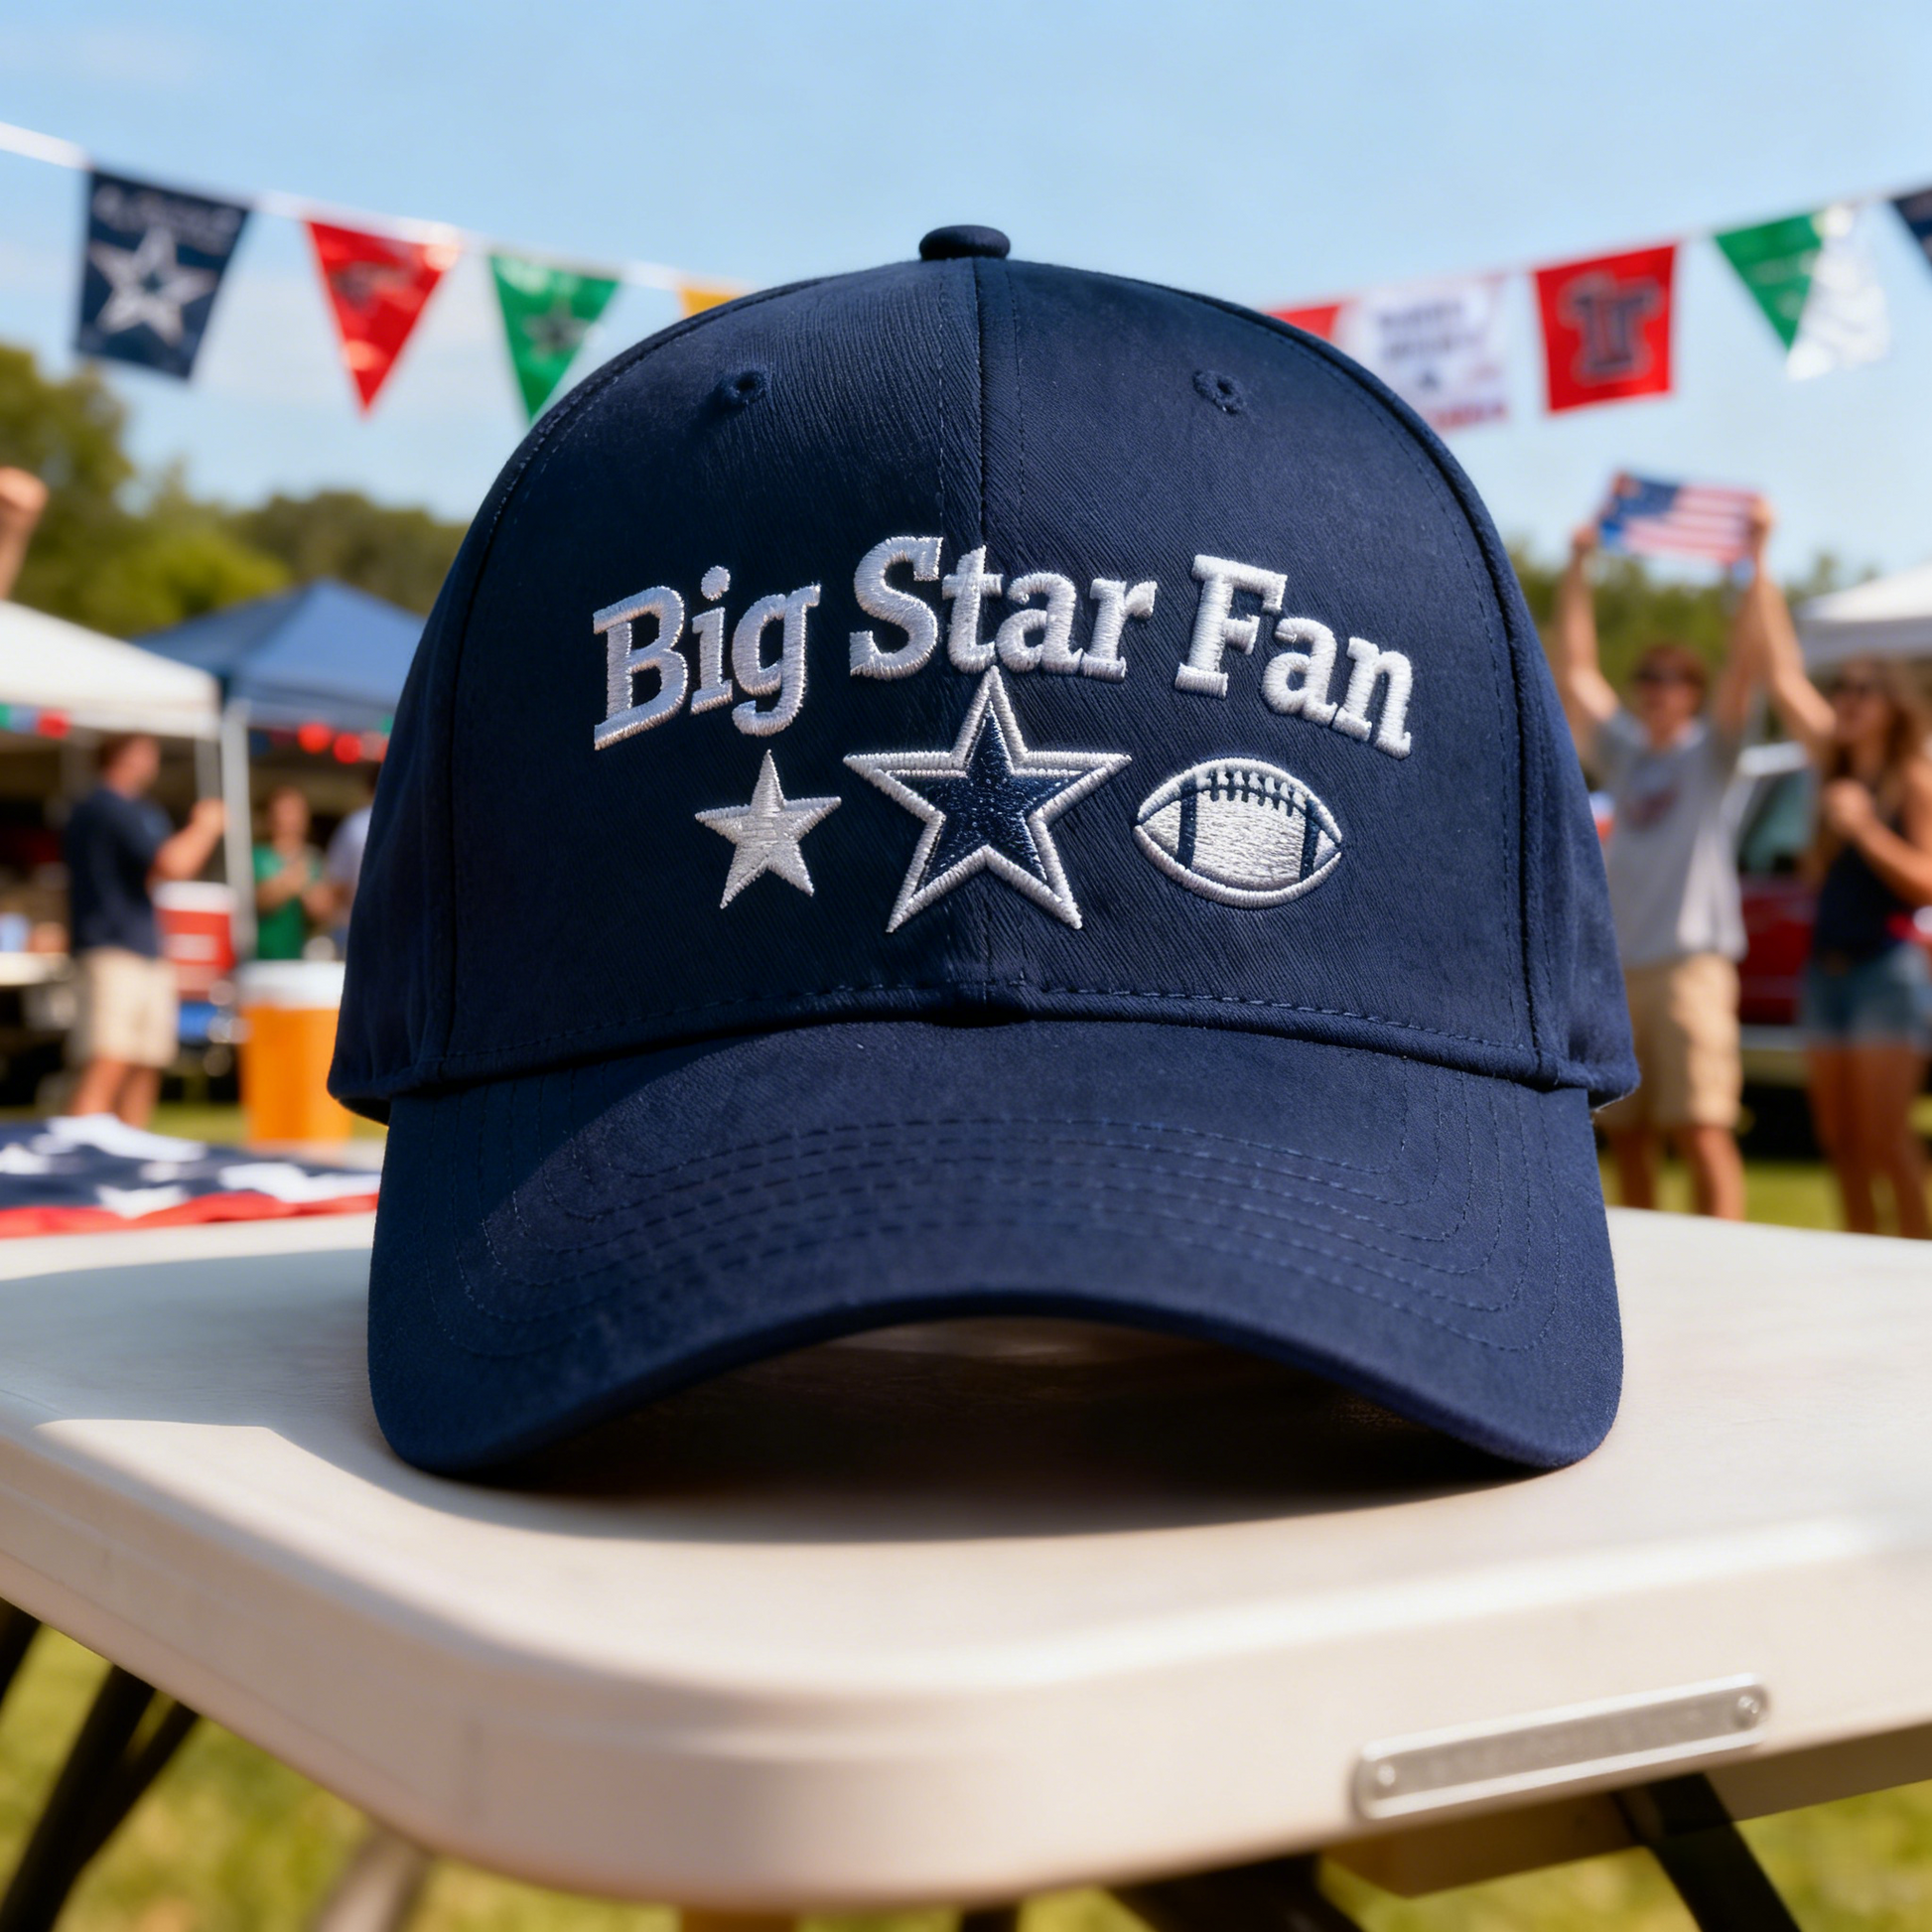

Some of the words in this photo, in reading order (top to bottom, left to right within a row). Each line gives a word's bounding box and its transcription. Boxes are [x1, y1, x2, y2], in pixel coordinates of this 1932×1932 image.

[593, 566, 822, 751] Big
[849, 536, 1157, 681] Star
[1175, 554, 1413, 758] Fan
